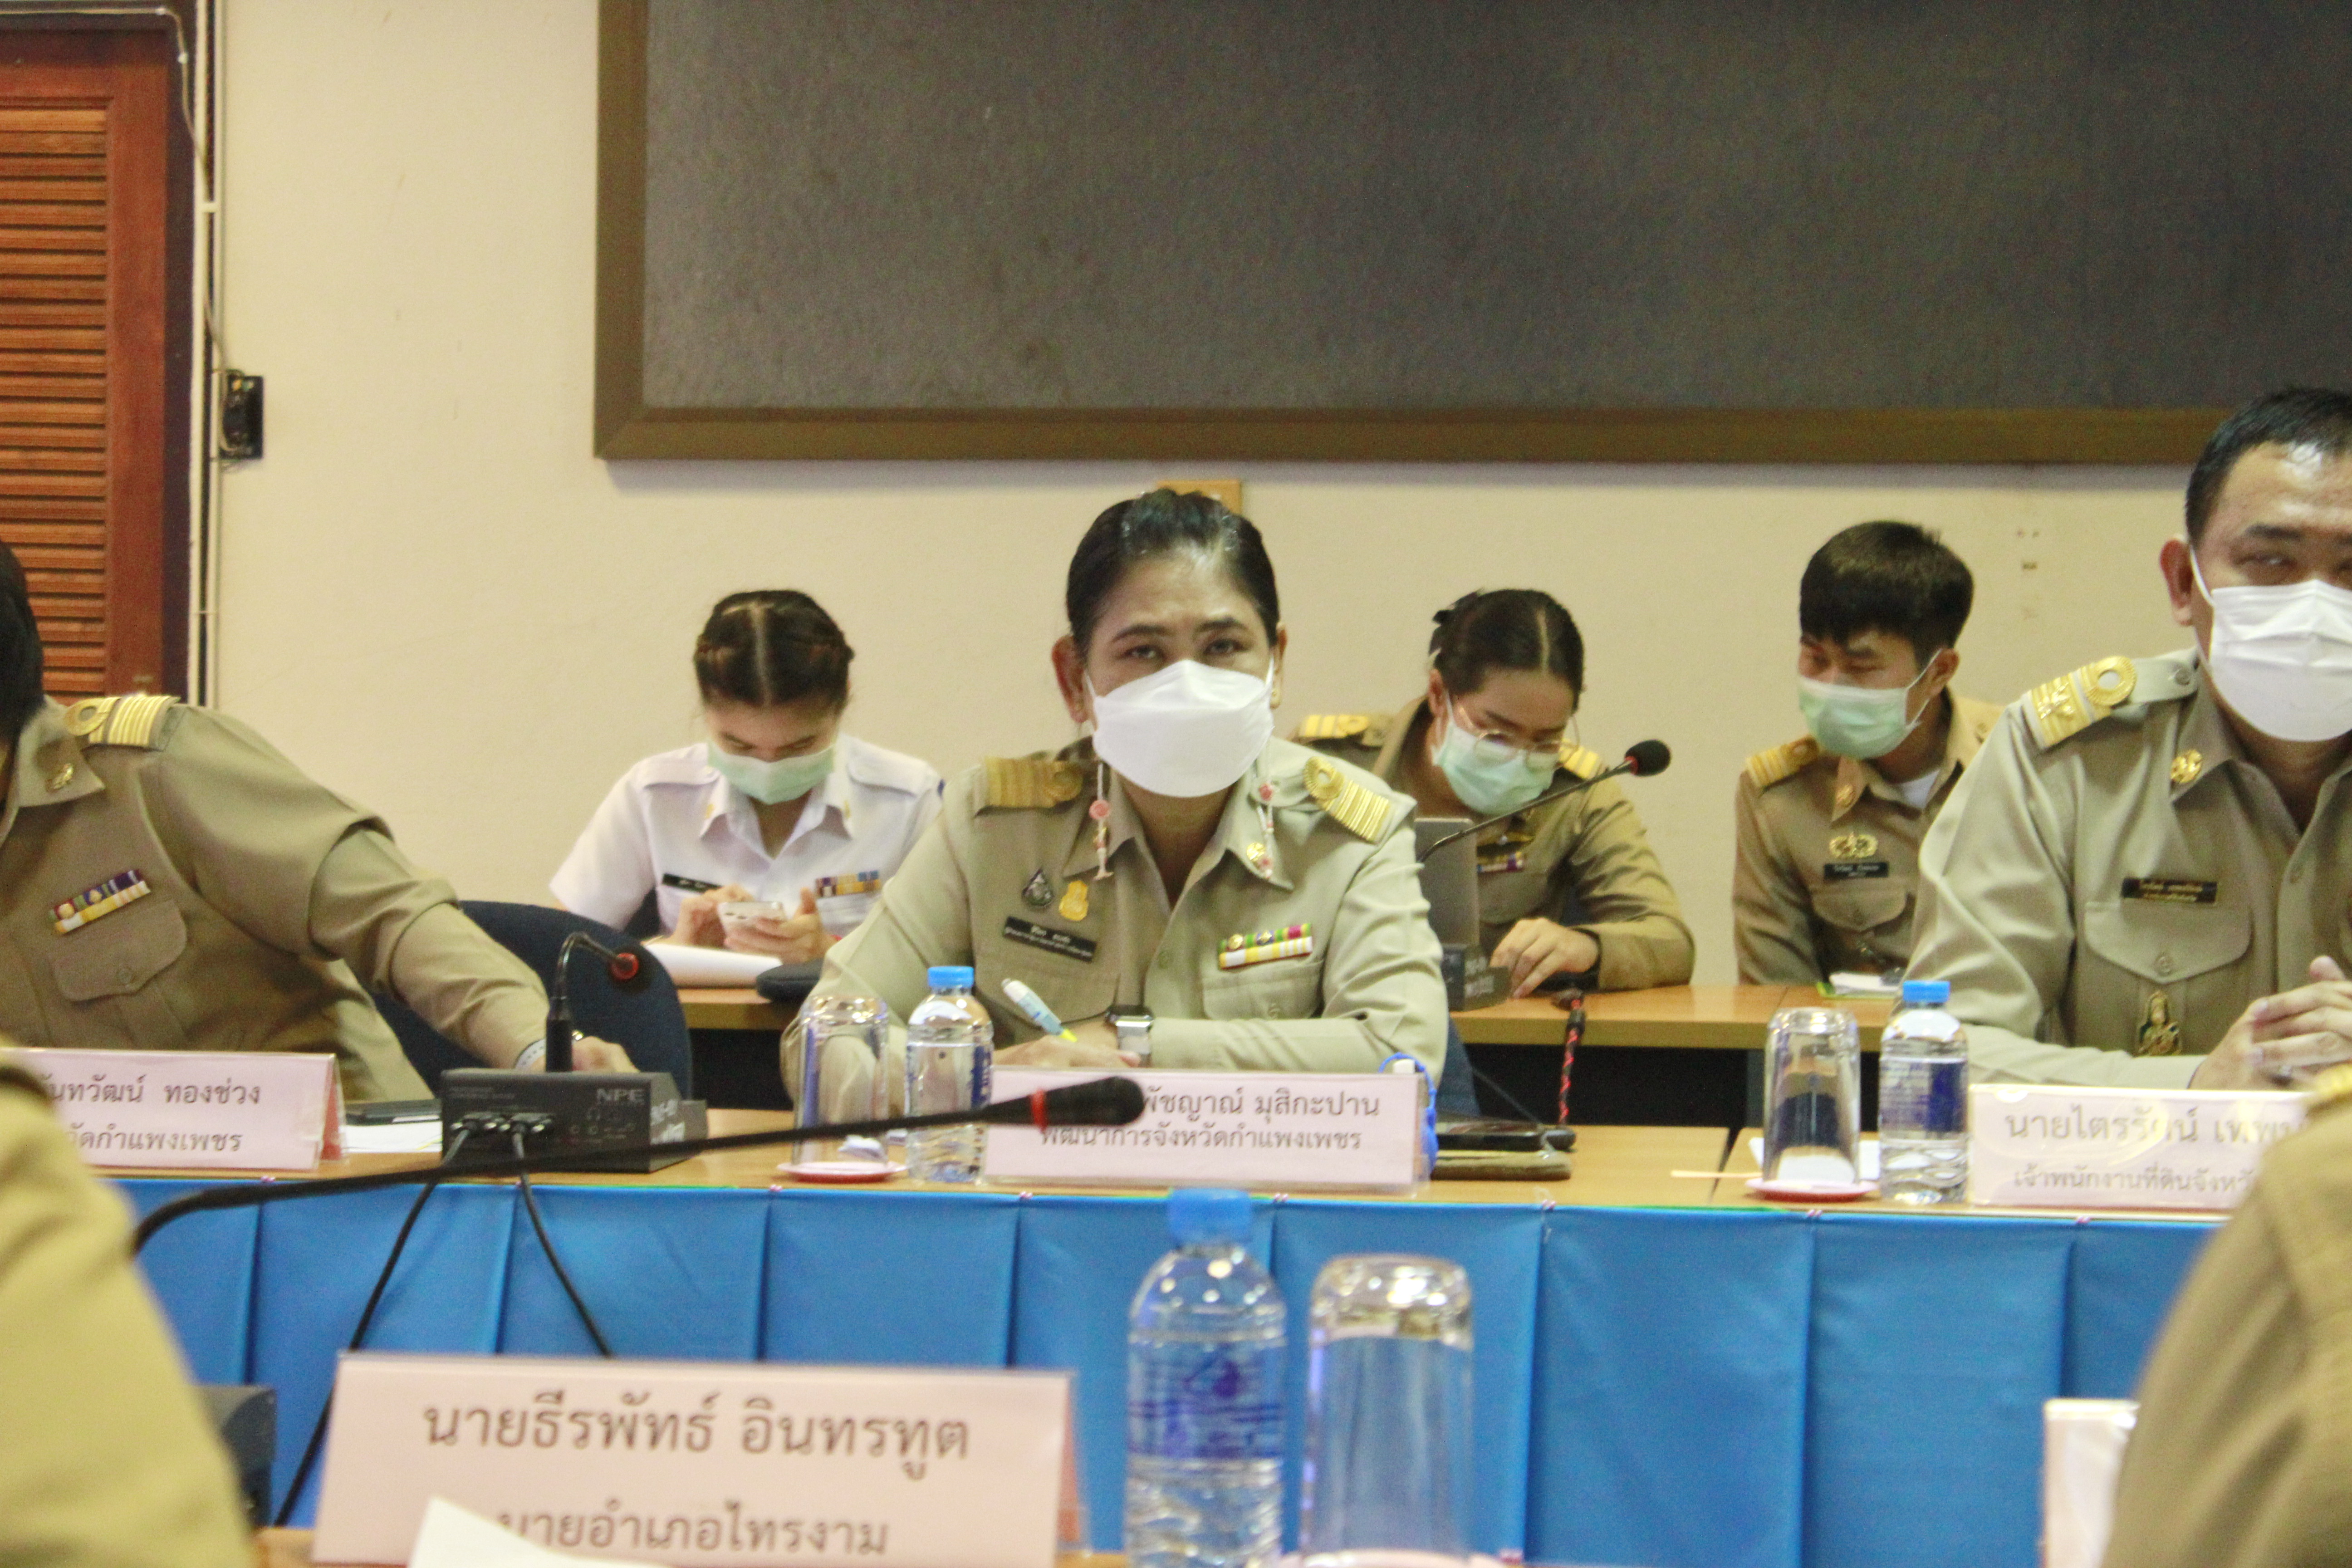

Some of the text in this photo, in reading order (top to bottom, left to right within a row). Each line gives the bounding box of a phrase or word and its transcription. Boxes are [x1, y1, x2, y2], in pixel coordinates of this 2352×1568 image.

[42, 1074, 261, 1104] ันทวัฒน์ ทองช่วง
[1255, 1087, 1380, 1124] มุสิกะปาน
[1042, 1122, 1362, 1150] พฒนาการจังหวัดกำแพงเพชร
[423, 1389, 970, 1482] นายธีรพัทธ์ อินทรทูต
